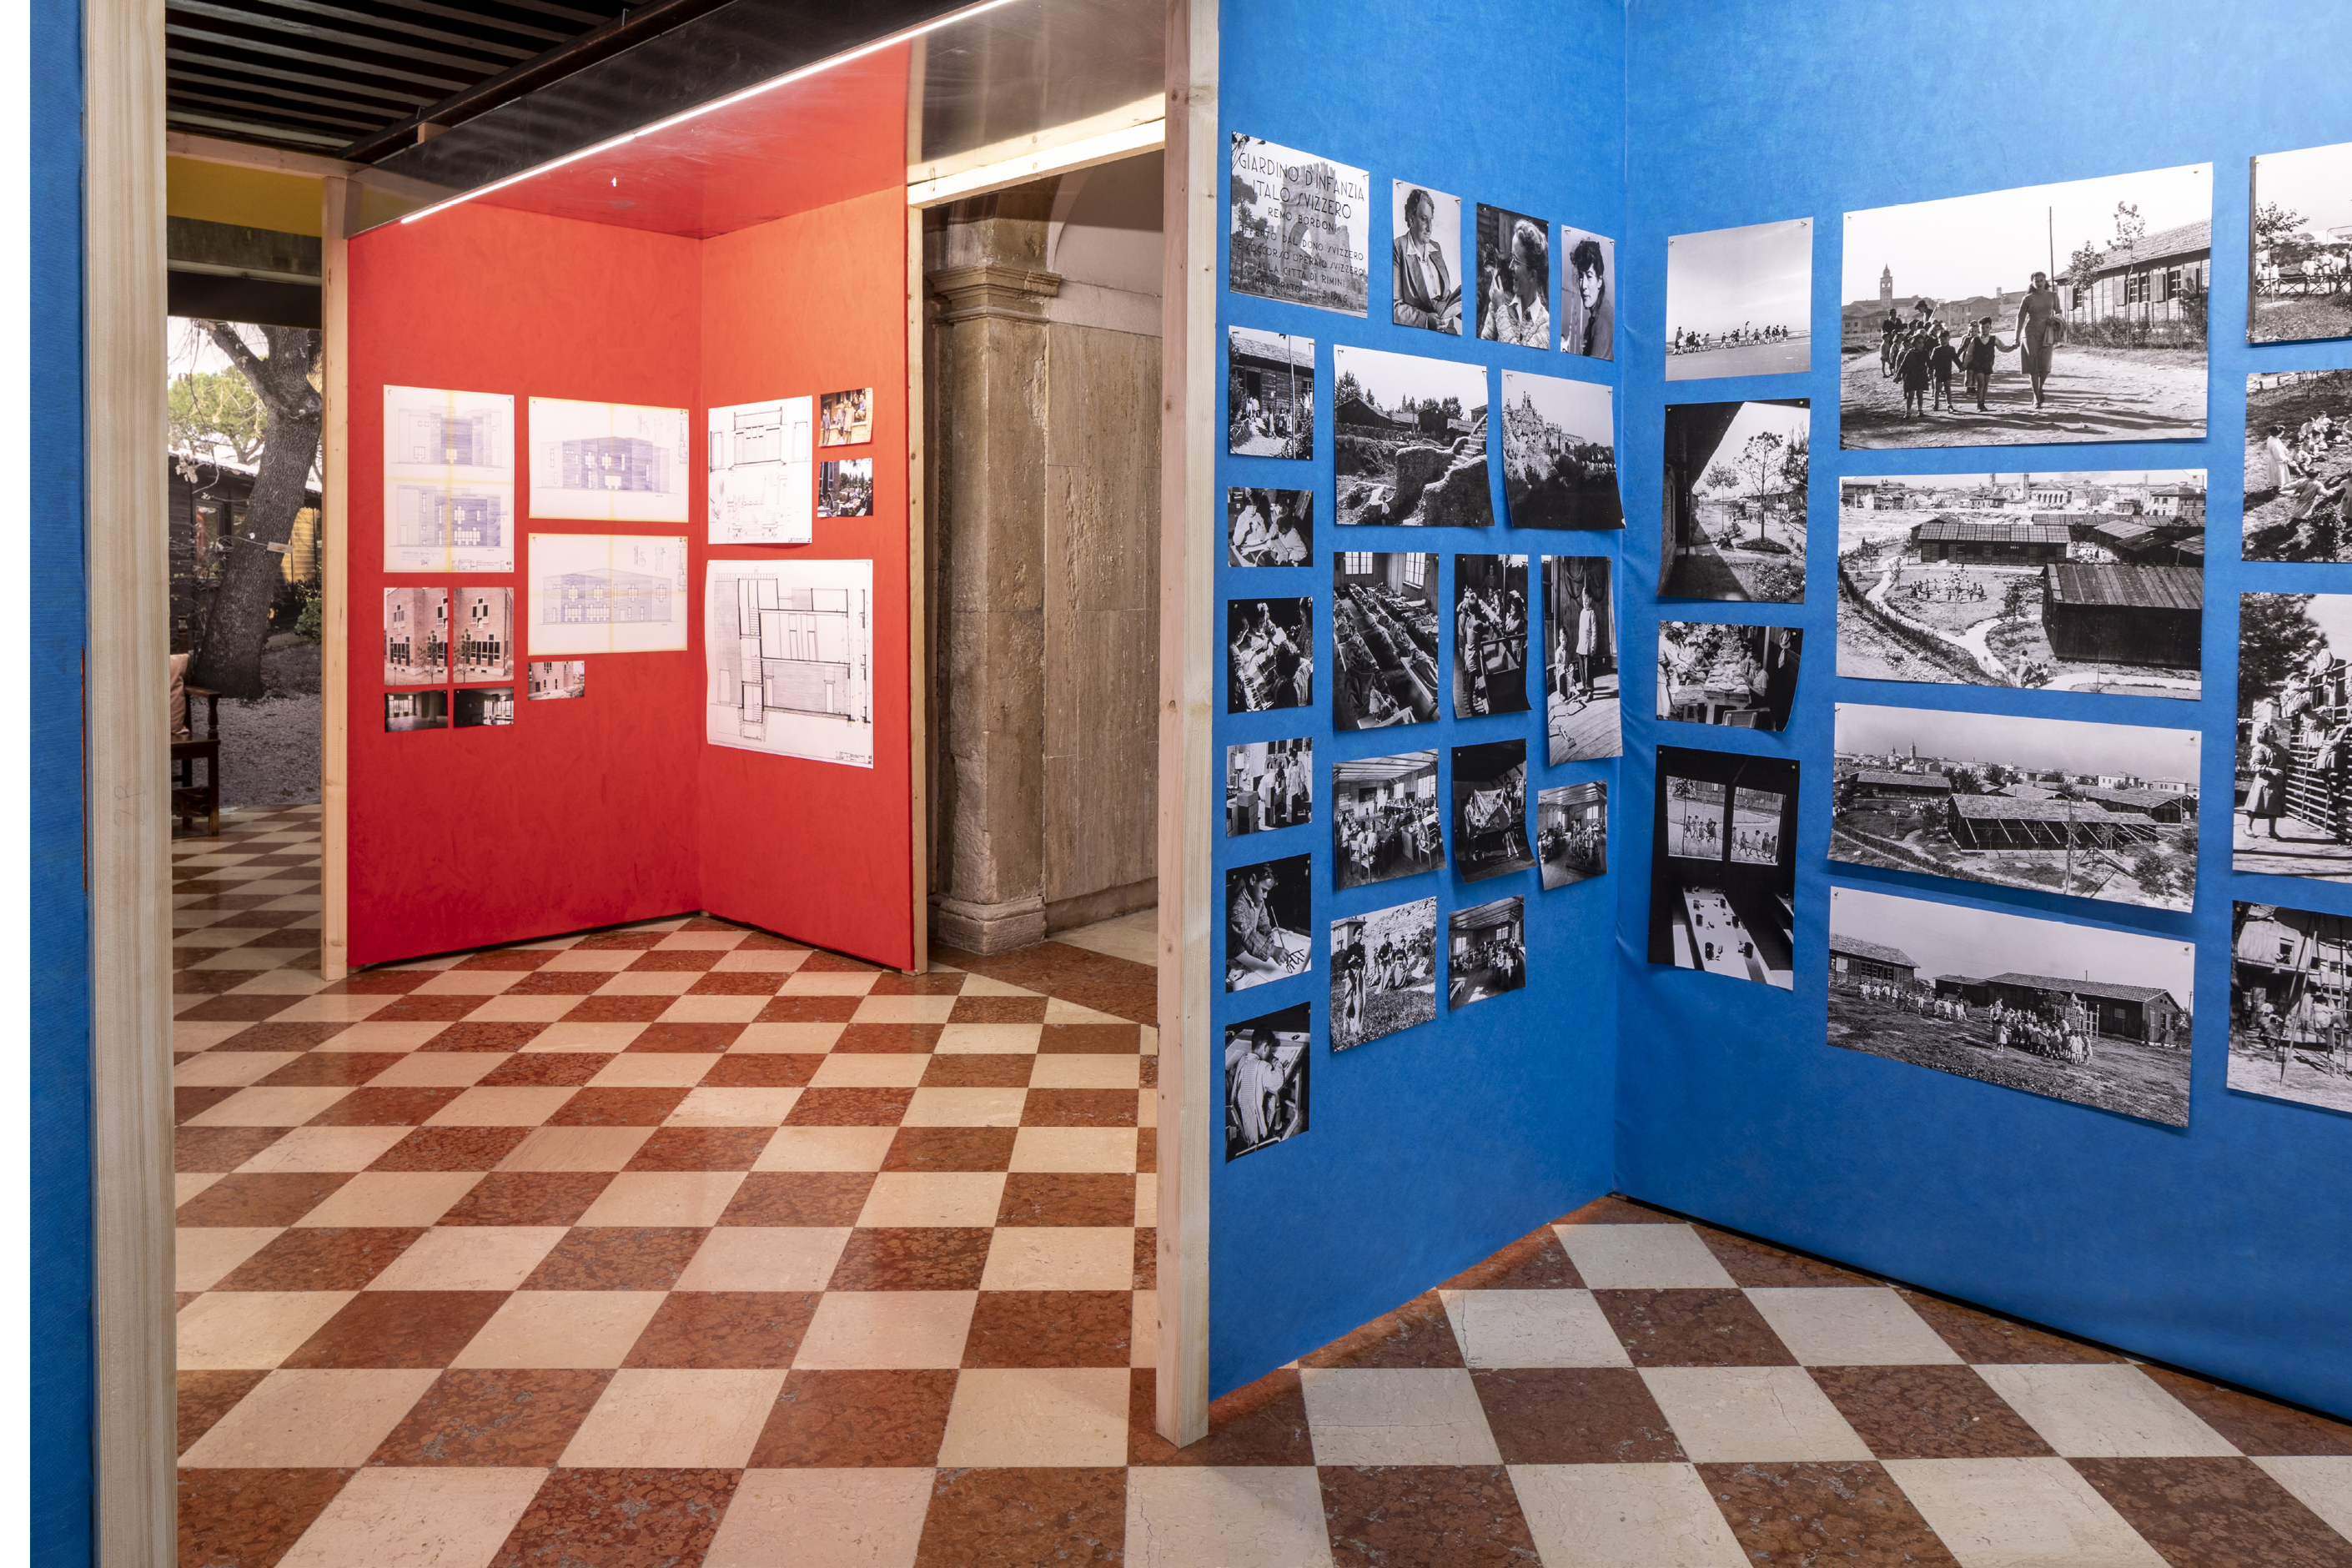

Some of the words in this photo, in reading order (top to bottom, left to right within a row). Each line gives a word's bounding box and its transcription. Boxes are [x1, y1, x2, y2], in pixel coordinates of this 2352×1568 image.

[1239, 153, 1299, 182] GIARDINO
[1253, 179, 1290, 203] ITALO
[1297, 193, 1351, 219] SVIZZERO
[1269, 207, 1292, 221] REMO
[1299, 215, 1336, 232] BORDONI
[1238, 225, 1276, 241] OFFERTO
[1283, 235, 1298, 245] DAL
[1303, 239, 1323, 251] DONO
[1328, 246, 1364, 260] SVIZZERO
[1238, 241, 1242, 249] E
[1246, 243, 1289, 260] SOCCORSO
[1293, 254, 1327, 268] OPERAIO
[1330, 262, 1364, 276] SVIZZERO
[1253, 277, 1300, 293] INAUGURATO
[1305, 287, 1312, 296] IL
[1258, 262, 1278, 273] ALLA
[1310, 273, 1317, 281] DI
[1322, 274, 1344, 287] RIMINI
